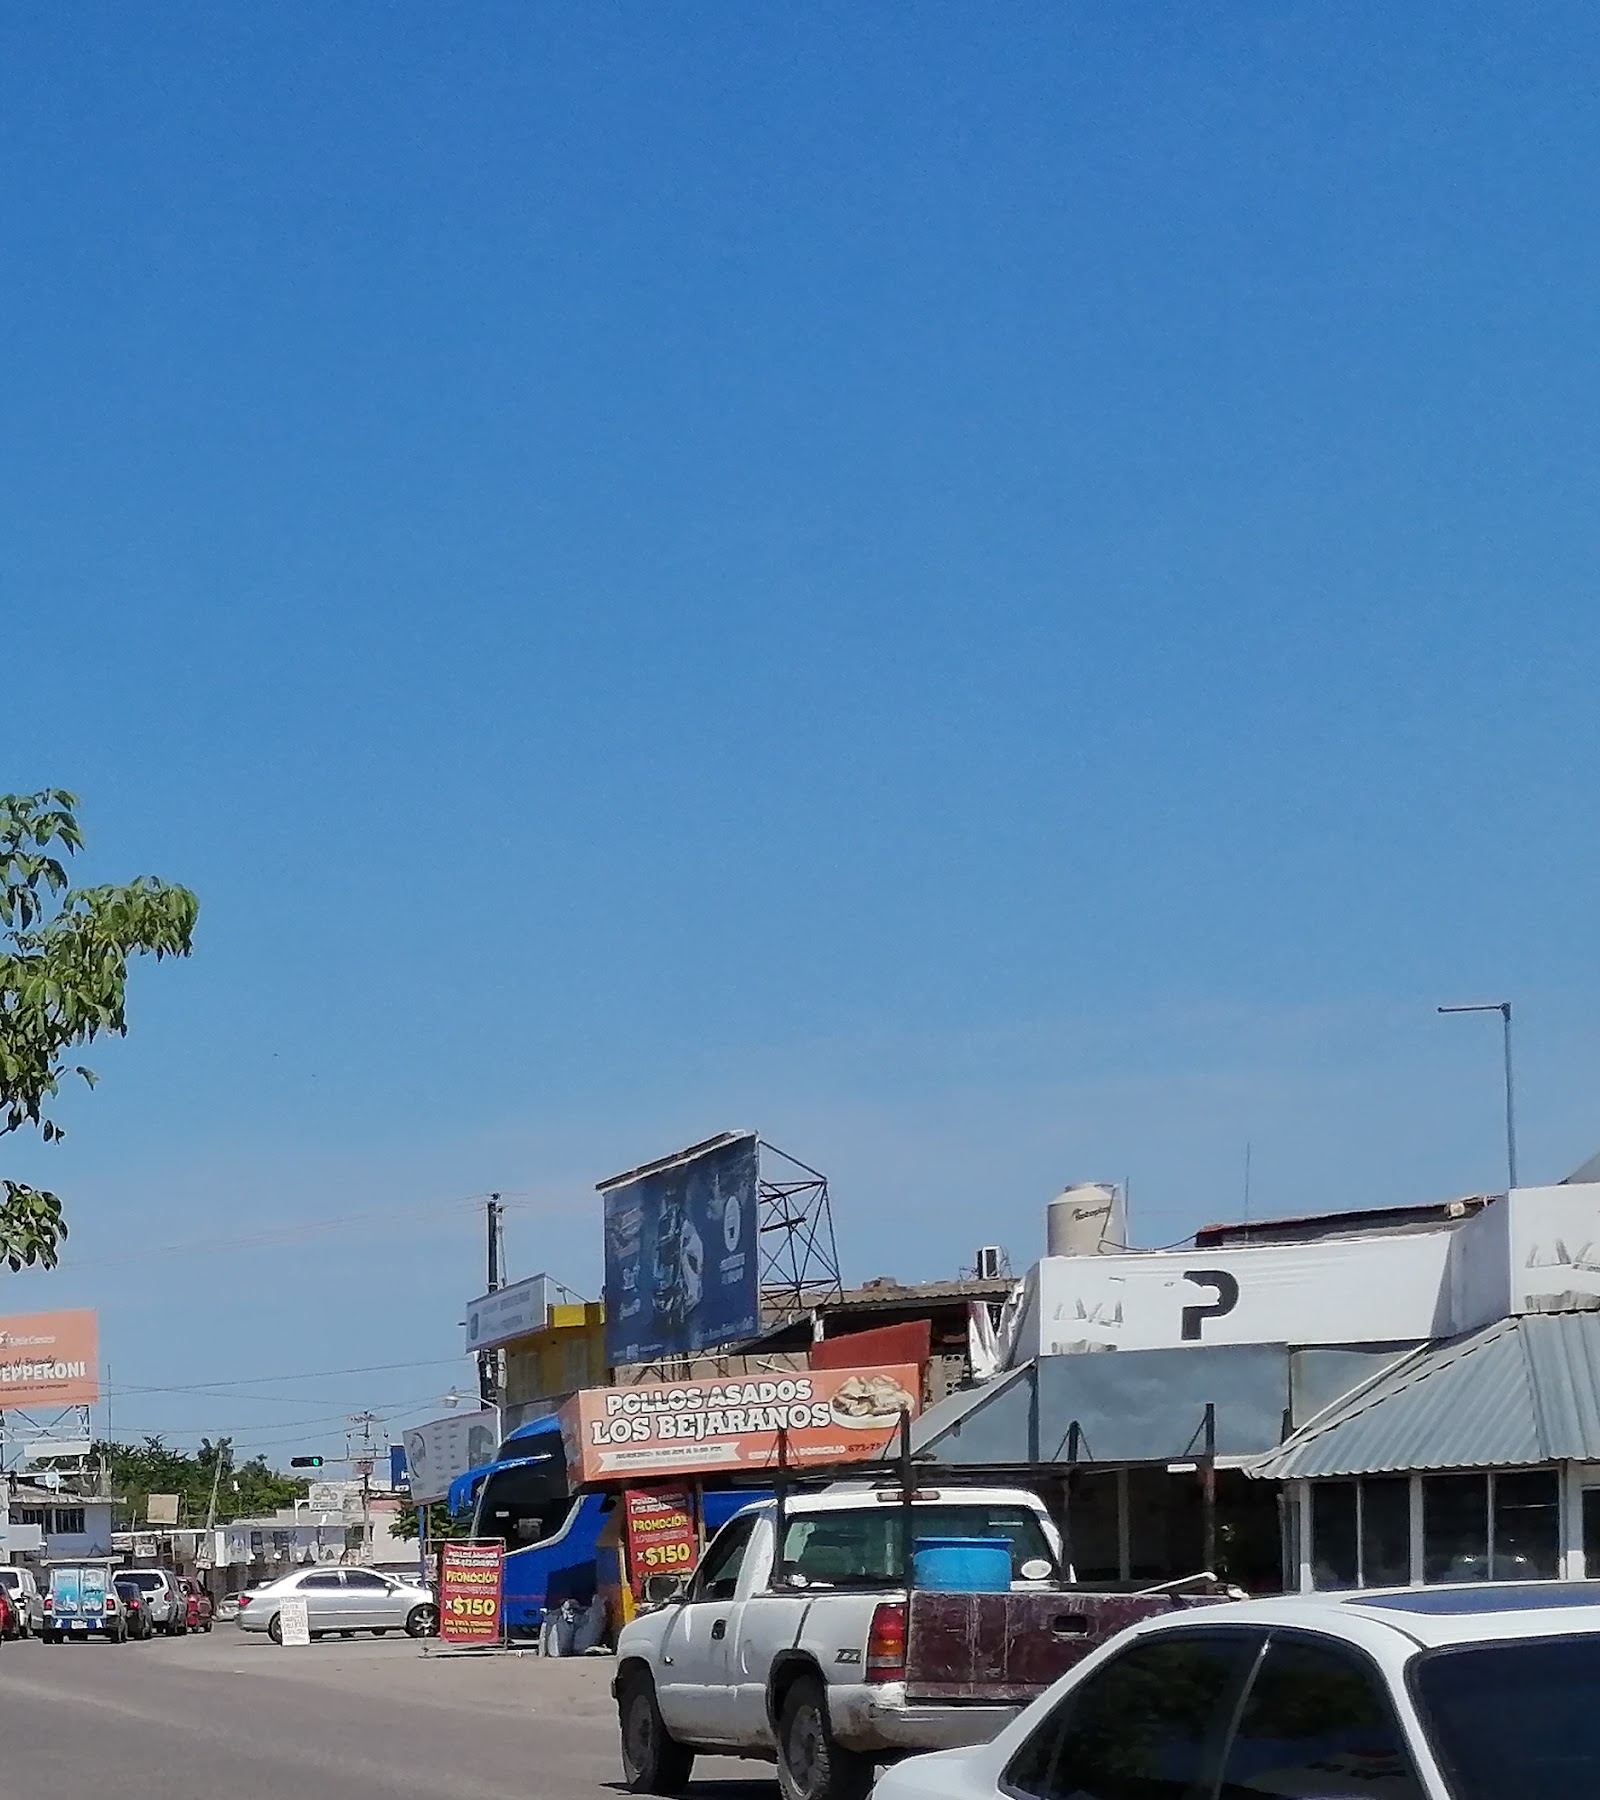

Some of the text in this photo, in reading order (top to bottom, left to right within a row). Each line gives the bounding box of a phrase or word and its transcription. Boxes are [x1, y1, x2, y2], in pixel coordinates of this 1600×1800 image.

[606, 1379, 812, 1416] POLLOS ASADOS
[591, 1401, 832, 1445] LOS BEJARANOS
